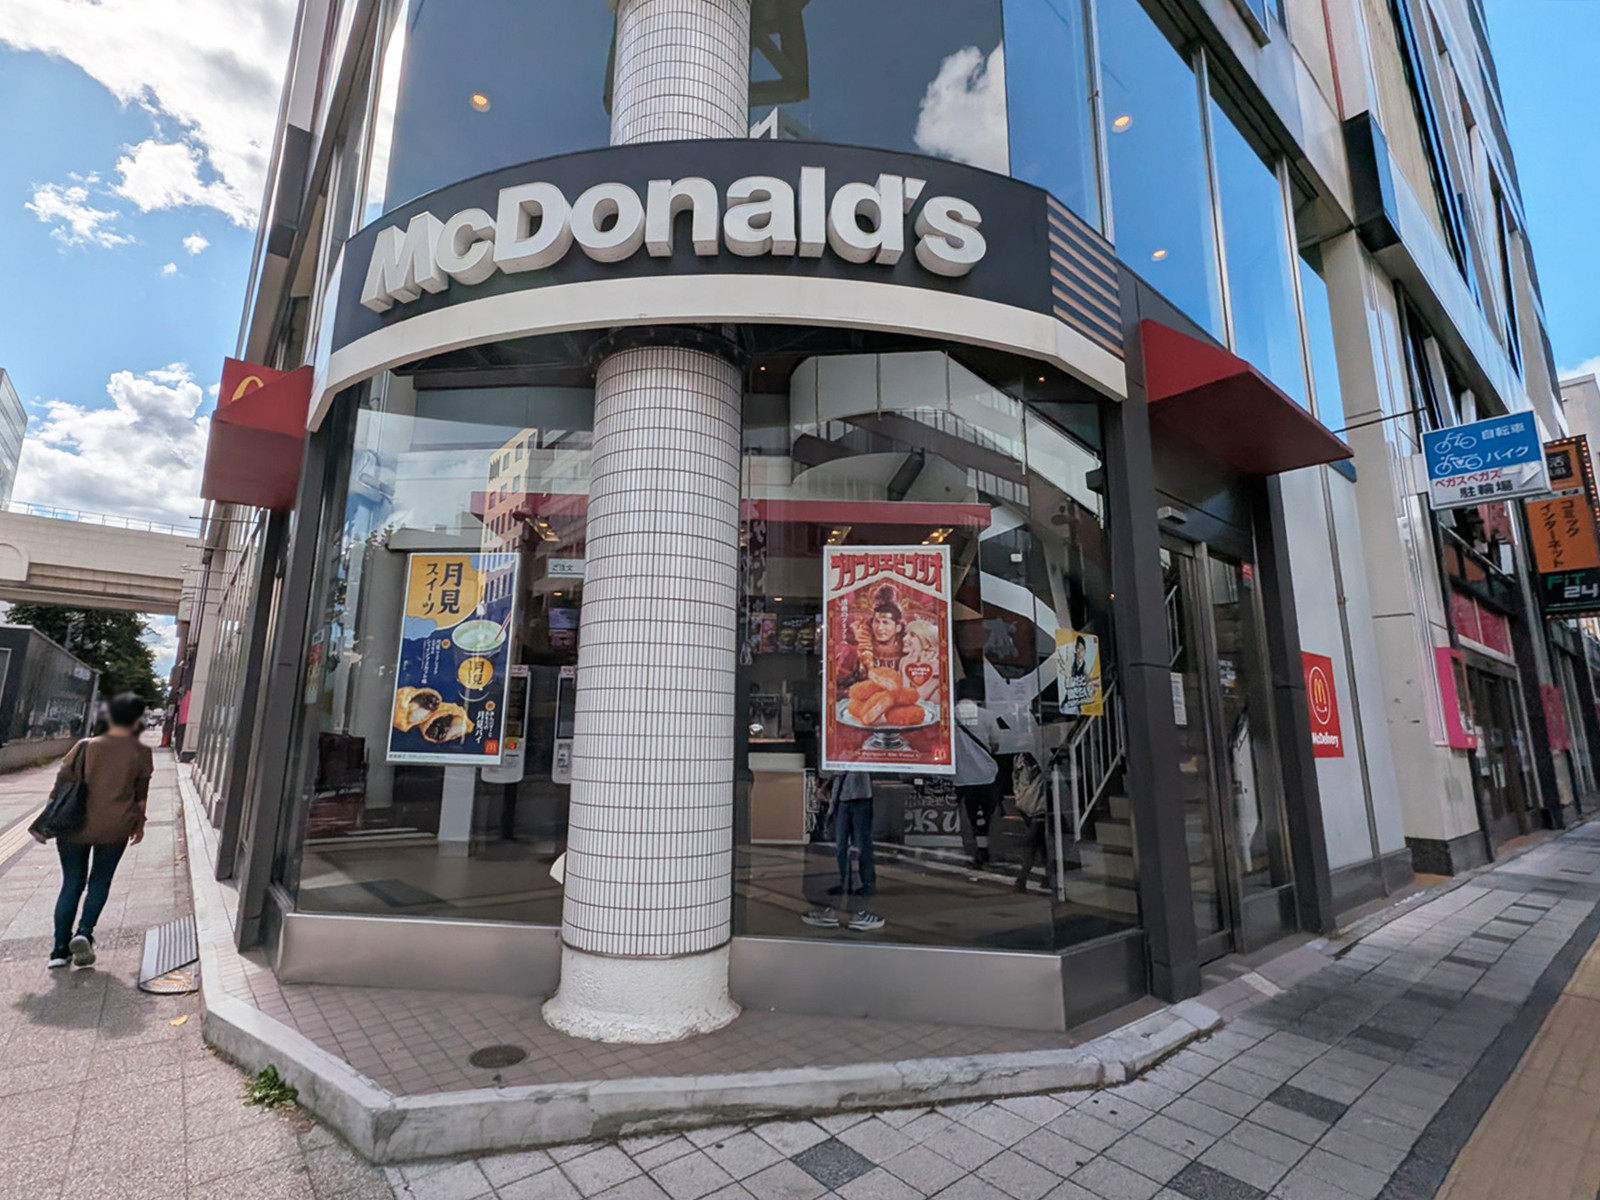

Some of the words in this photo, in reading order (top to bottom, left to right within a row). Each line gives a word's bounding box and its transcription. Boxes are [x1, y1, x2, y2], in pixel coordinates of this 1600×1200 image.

[360, 166, 988, 313] McDonald's
[1481, 421, 1526, 441] 自転車
[1486, 445, 1529, 464] バイク
[1459, 479, 1514, 499] 駐輪場
[1541, 502, 1564, 568] インターネット
[1560, 500, 1580, 538] コミック
[422, 563, 439, 616] スイーツ
[437, 562, 464, 615] 月見
[1564, 583, 1599, 598] 24
